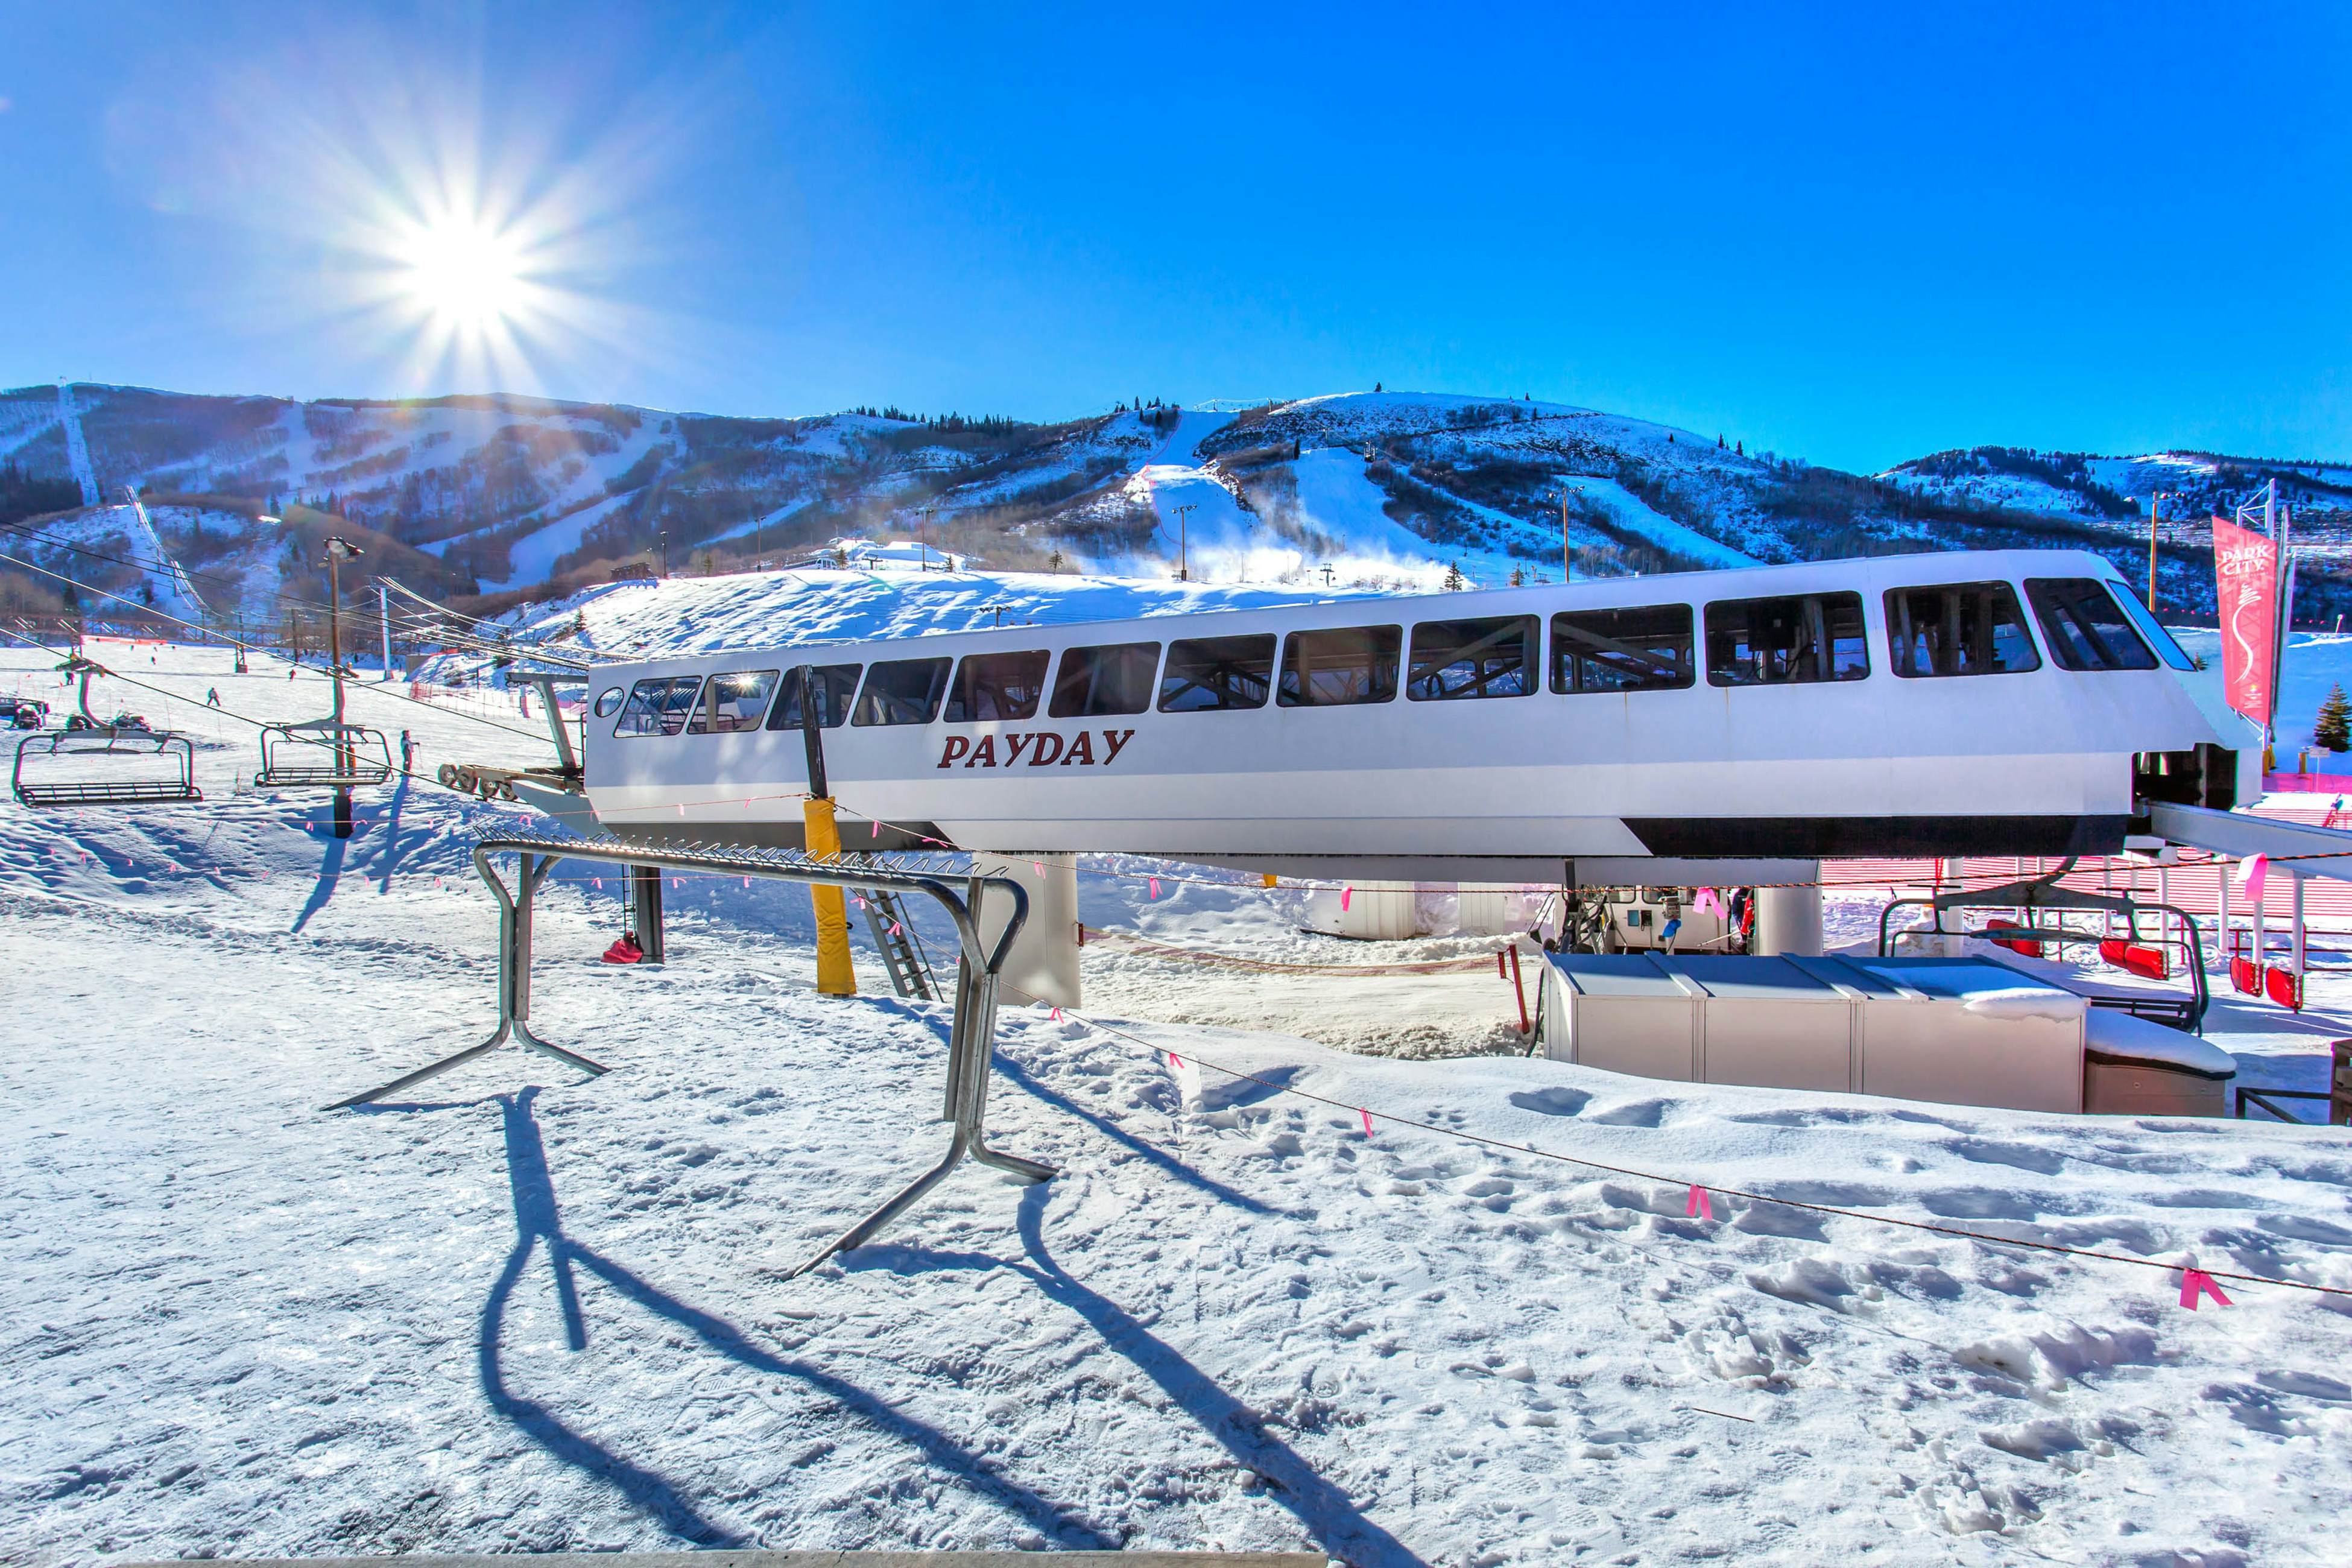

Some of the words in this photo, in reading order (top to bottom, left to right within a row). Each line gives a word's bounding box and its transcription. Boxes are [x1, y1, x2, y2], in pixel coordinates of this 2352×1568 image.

[2222, 545, 2268, 563] PARK
[2224, 558, 2265, 575] CITY
[937, 729, 1135, 768] PAYDAY
